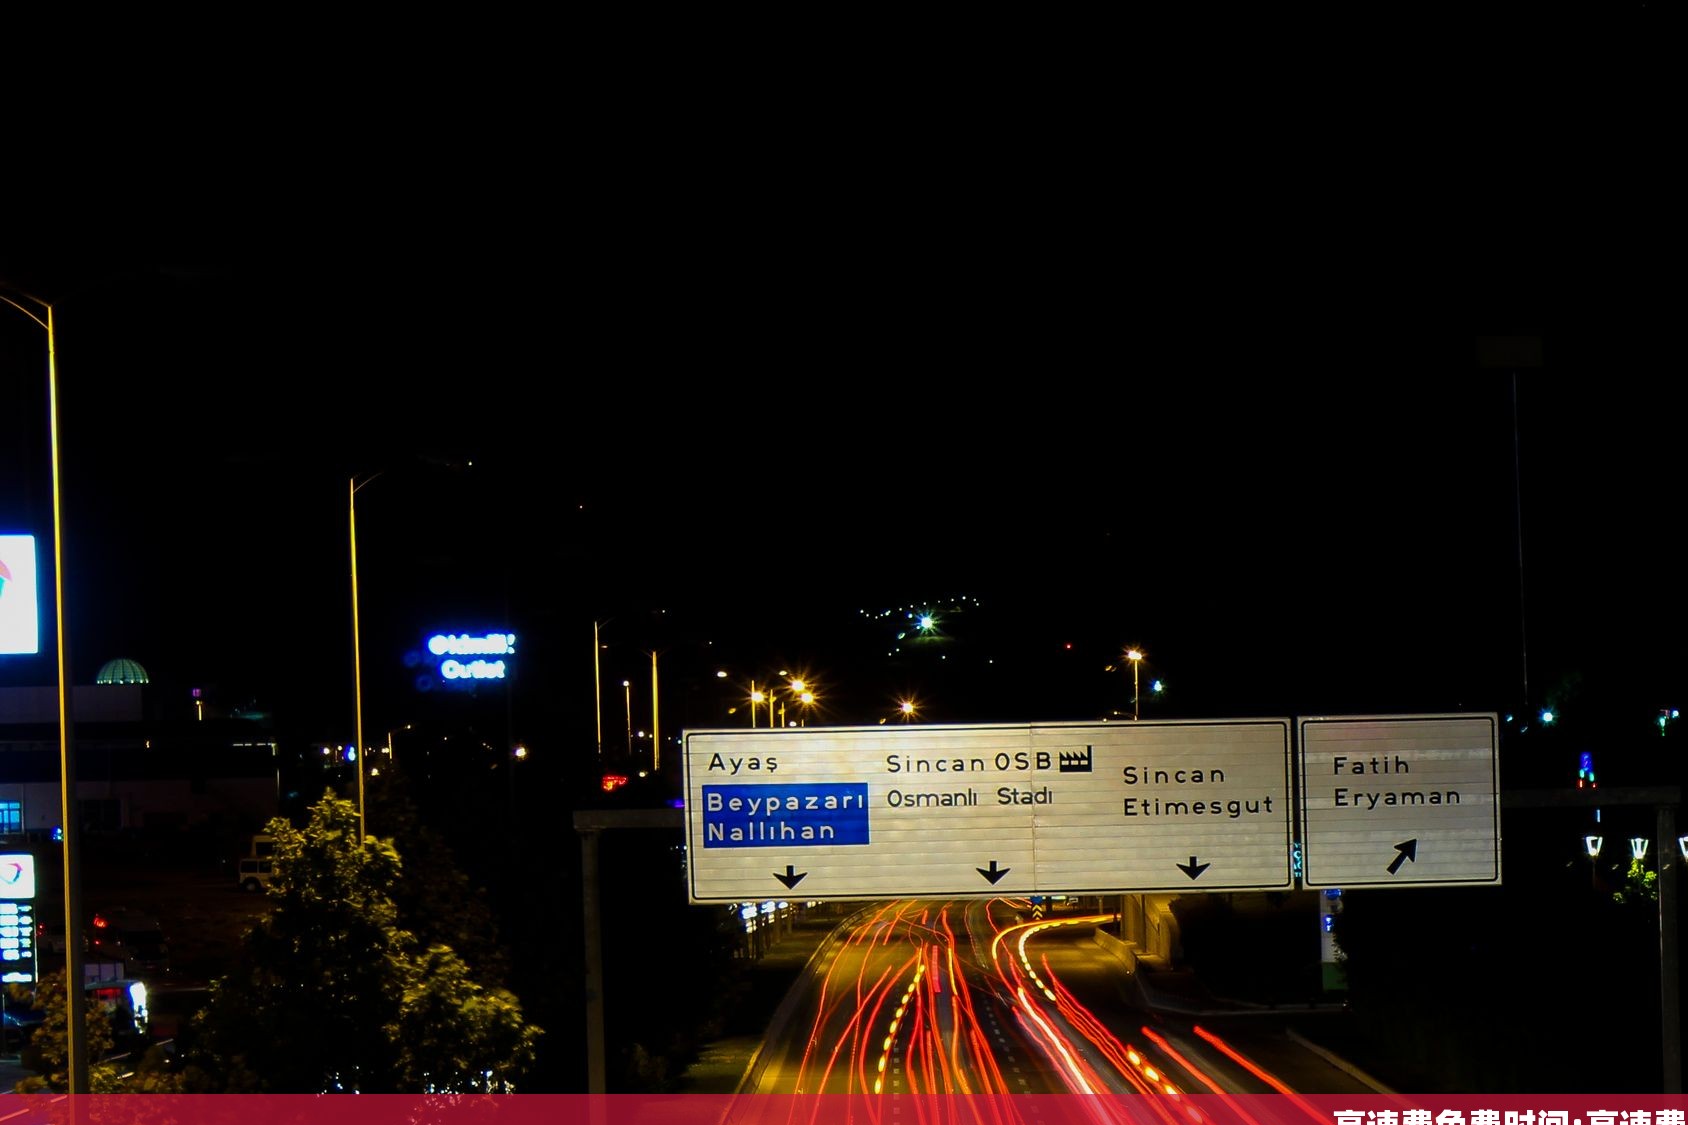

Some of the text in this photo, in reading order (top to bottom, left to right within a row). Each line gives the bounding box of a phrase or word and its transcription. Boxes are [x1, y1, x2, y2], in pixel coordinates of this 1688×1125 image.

[708, 753, 778, 775] Ayaş
[886, 752, 1051, 773] Sincan OSB
[1334, 756, 1409, 775] Fatih
[1123, 766, 1225, 785] Sincan
[707, 793, 863, 816] Beypazarı
[887, 786, 1053, 807] Osmanlı Stadı
[1124, 796, 1272, 818] Etimesgut
[1334, 788, 1460, 810] Eryaman
[708, 821, 835, 841] Nallıhan
